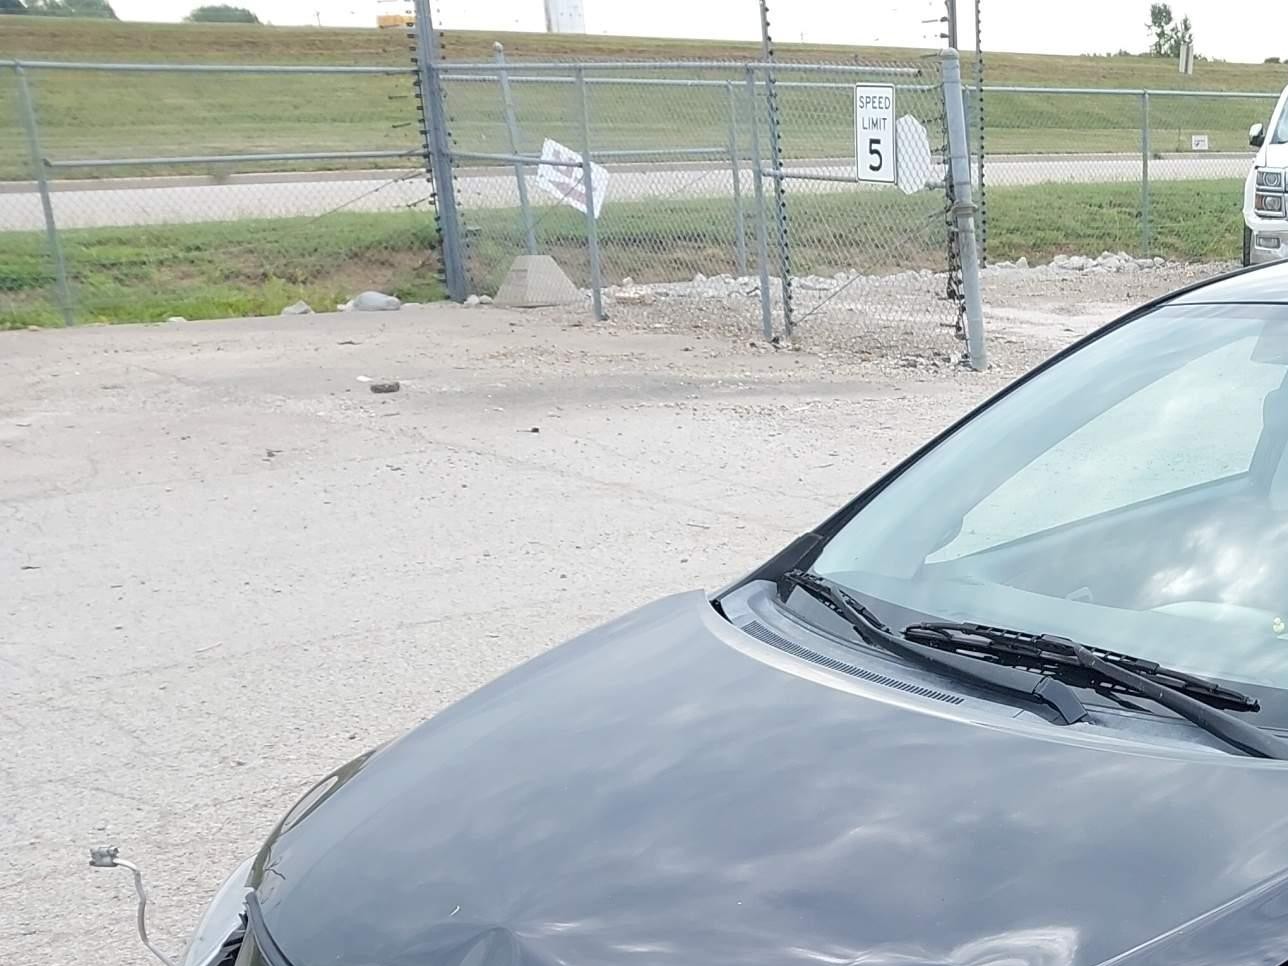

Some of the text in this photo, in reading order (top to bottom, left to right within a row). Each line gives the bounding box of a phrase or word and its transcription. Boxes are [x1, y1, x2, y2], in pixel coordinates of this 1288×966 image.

[859, 96, 890, 109] SPEED
[863, 118, 887, 131] LIMIT
[869, 139, 882, 171] 5
